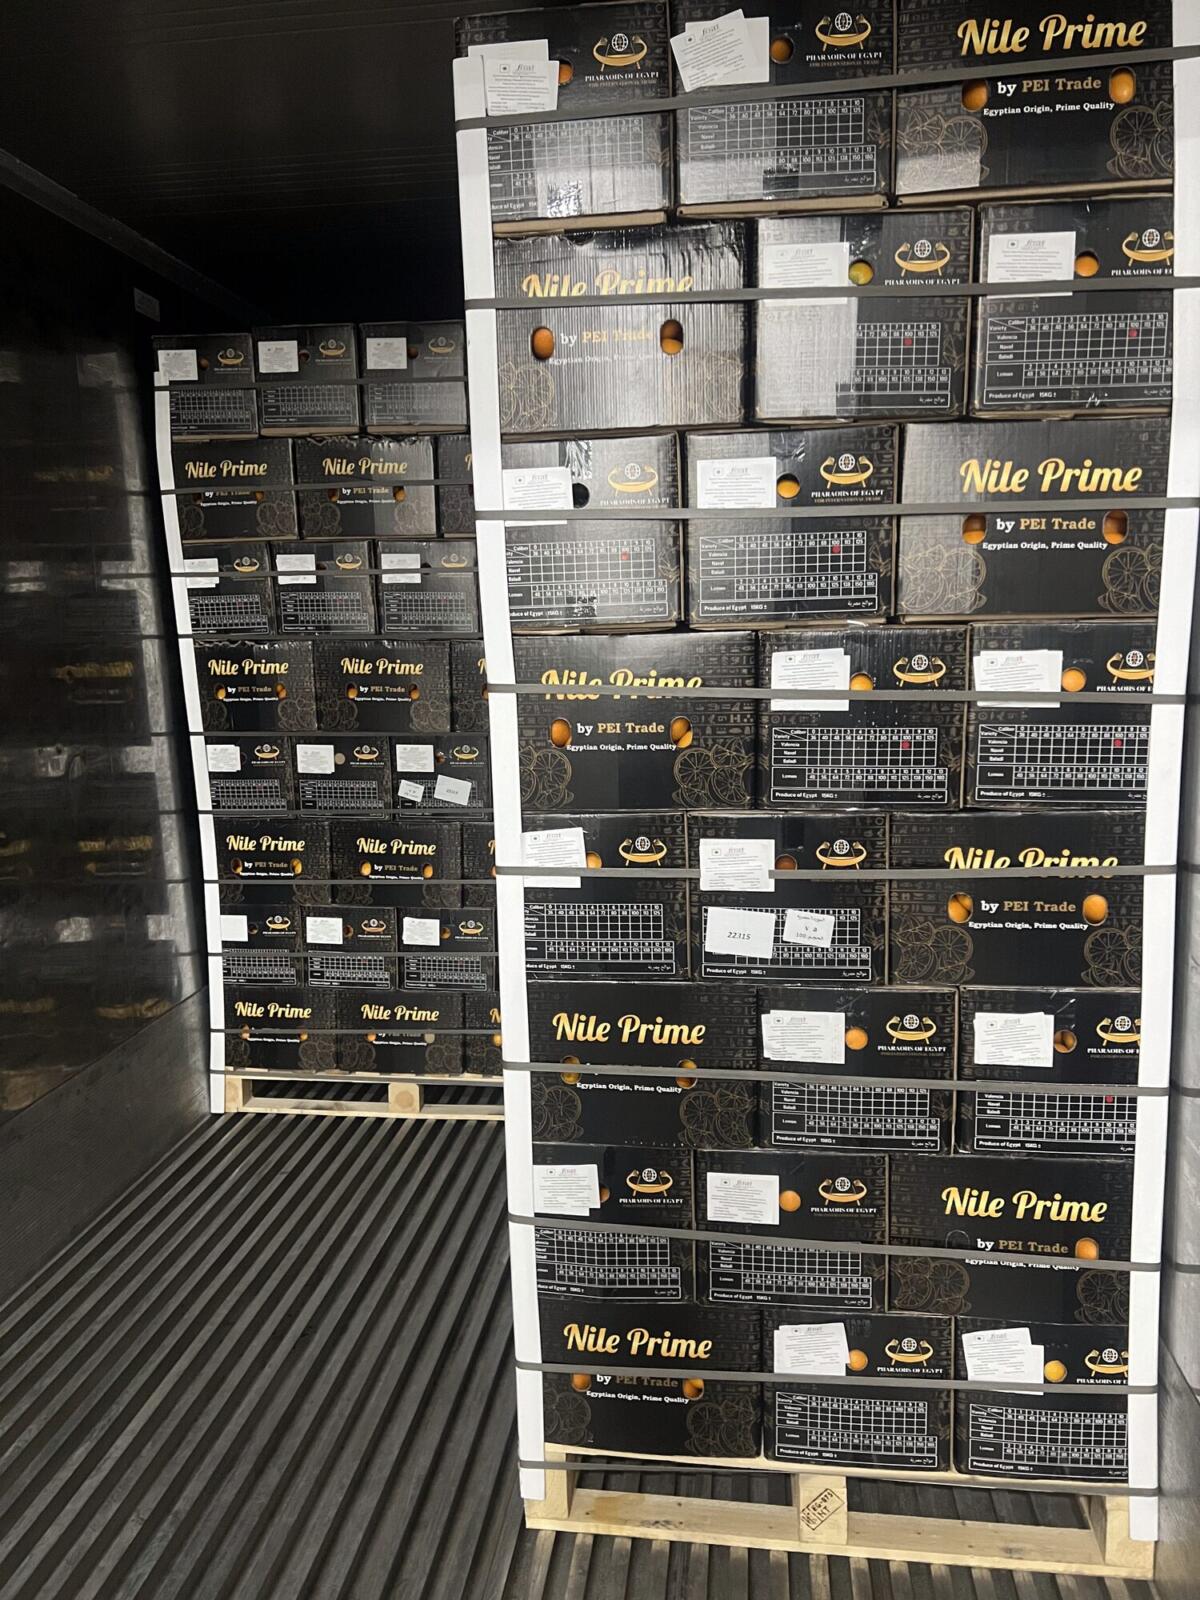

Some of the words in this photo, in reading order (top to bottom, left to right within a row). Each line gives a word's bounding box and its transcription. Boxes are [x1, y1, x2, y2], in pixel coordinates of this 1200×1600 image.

[957, 19, 1030, 56] Nile
[1038, 14, 1147, 50] Prime
[858, 51, 882, 59] EGYPT
[998, 82, 1017, 96] by
[1022, 80, 1049, 93] PEI
[1055, 77, 1101, 90] Trade
[983, 107, 1021, 117] Egyptian
[1024, 104, 1053, 114] Origin,
[1055, 103, 1081, 111] Prime
[1083, 101, 1115, 111] Quality
[522, 274, 587, 297] Nile
[595, 267, 694, 296] Prime
[561, 333, 577, 347] by
[582, 331, 607, 343] PEI
[185, 461, 217, 479] Nile
[220, 459, 268, 477] Prime
[322, 458, 354, 475] Nile
[359, 457, 408, 474] Prime
[960, 458, 1029, 493] Nile
[1038, 457, 1142, 493] Prime
[342, 487, 351, 495] by
[996, 518, 1015, 532] by
[1020, 519, 1045, 529] PEI
[1051, 518, 1096, 530] Trade
[982, 542, 1018, 550] Egyptian
[1020, 542, 1049, 550] Origin,
[1077, 542, 1108, 550] Quality
[208, 659, 238, 676] Nile
[242, 659, 288, 675] Prime
[340, 657, 372, 674] Nile
[376, 658, 424, 676] Prime
[228, 686, 236, 695] by
[360, 685, 368, 694] by
[541, 669, 602, 700] Nile
[610, 669, 702, 699] Prime
[577, 723, 593, 736] by
[598, 723, 621, 733] PEI
[625, 723, 664, 733] Trade
[226, 835, 256, 851] Nile
[260, 835, 305, 852] Prime
[356, 838, 387, 854] Nile
[391, 839, 436, 856] Prime
[244, 861, 252, 869] by
[374, 864, 383, 872] by
[944, 847, 1011, 869] Nile
[1018, 847, 1118, 878] Prime
[981, 901, 999, 913] by
[1003, 901, 1029, 912] PEI
[1033, 901, 1076, 912] Trade
[969, 921, 1003, 930] Egyptian
[1005, 922, 1032, 930] Origin,
[1059, 923, 1088, 931] Quality
[234, 1002, 264, 1018] Nile
[268, 1003, 312, 1019] Prime
[361, 1004, 392, 1020] Nile
[394, 1005, 440, 1022] Prime
[552, 1012, 611, 1042] Nile
[618, 1014, 706, 1044] Prime
[576, 1083, 607, 1091] Egyptian
[656, 1086, 682, 1094] Quality
[941, 1187, 1005, 1217] Nile
[1012, 1190, 1107, 1223] Prime
[977, 1238, 994, 1251] by
[999, 1240, 1022, 1251] PEI
[1028, 1242, 1069, 1254] Trade
[563, 1324, 620, 1354] Nile
[627, 1328, 712, 1359] Prime
[596, 1374, 611, 1385] by
[616, 1375, 638, 1384] PEI
[643, 1377, 678, 1388] Trade
[586, 1390, 616, 1398] Egyptian
[617, 1393, 641, 1401] Origin,
[664, 1396, 689, 1404] Quality
